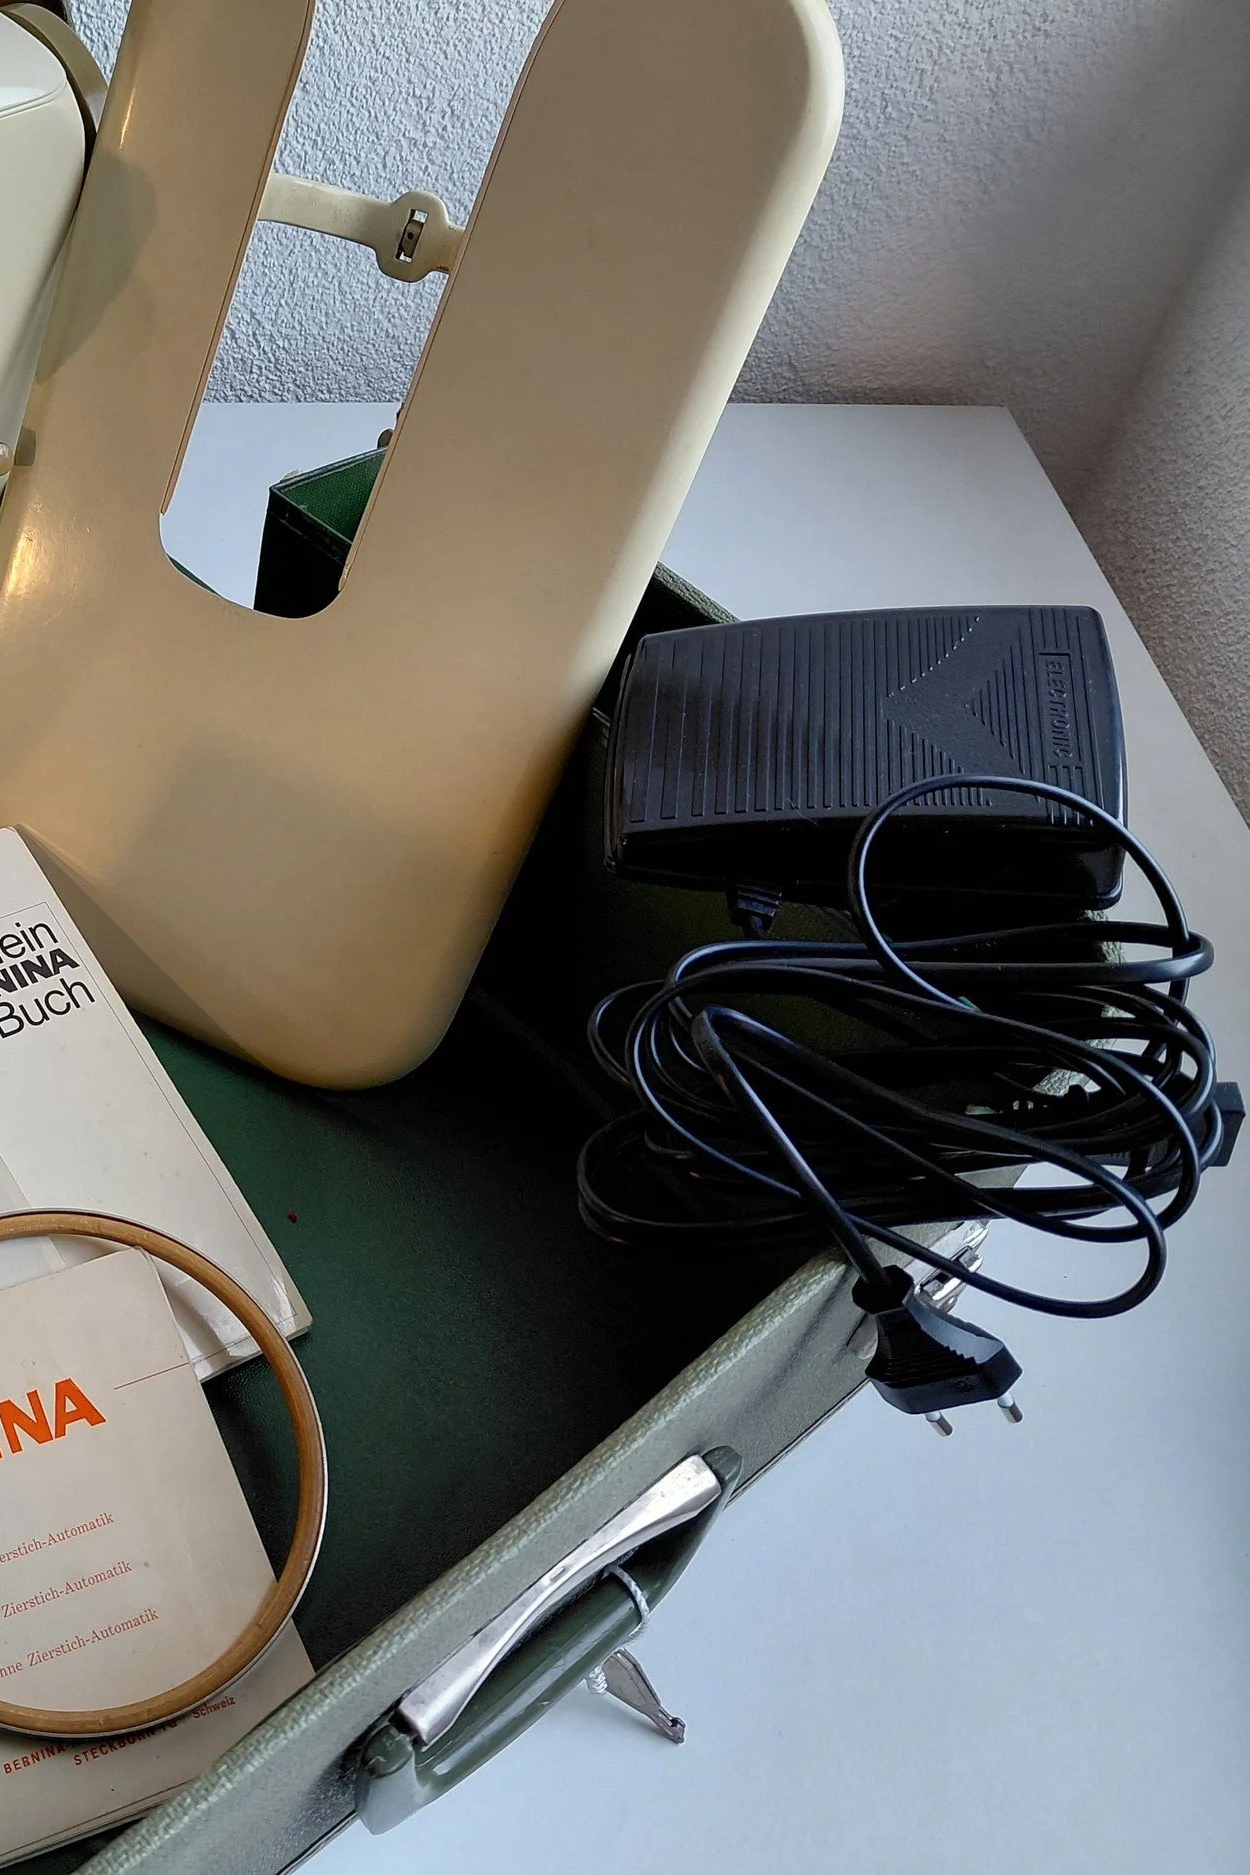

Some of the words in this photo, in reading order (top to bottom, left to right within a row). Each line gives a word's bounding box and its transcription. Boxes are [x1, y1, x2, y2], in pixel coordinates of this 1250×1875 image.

[1045, 659, 1073, 759] ELECTRONIC
[1, 1561, 131, 1617] Zierstich-Automatik
[26, 1608, 158, 1666] Zierstich-Automatik
[193, 1695, 236, 1719] Schweiz
